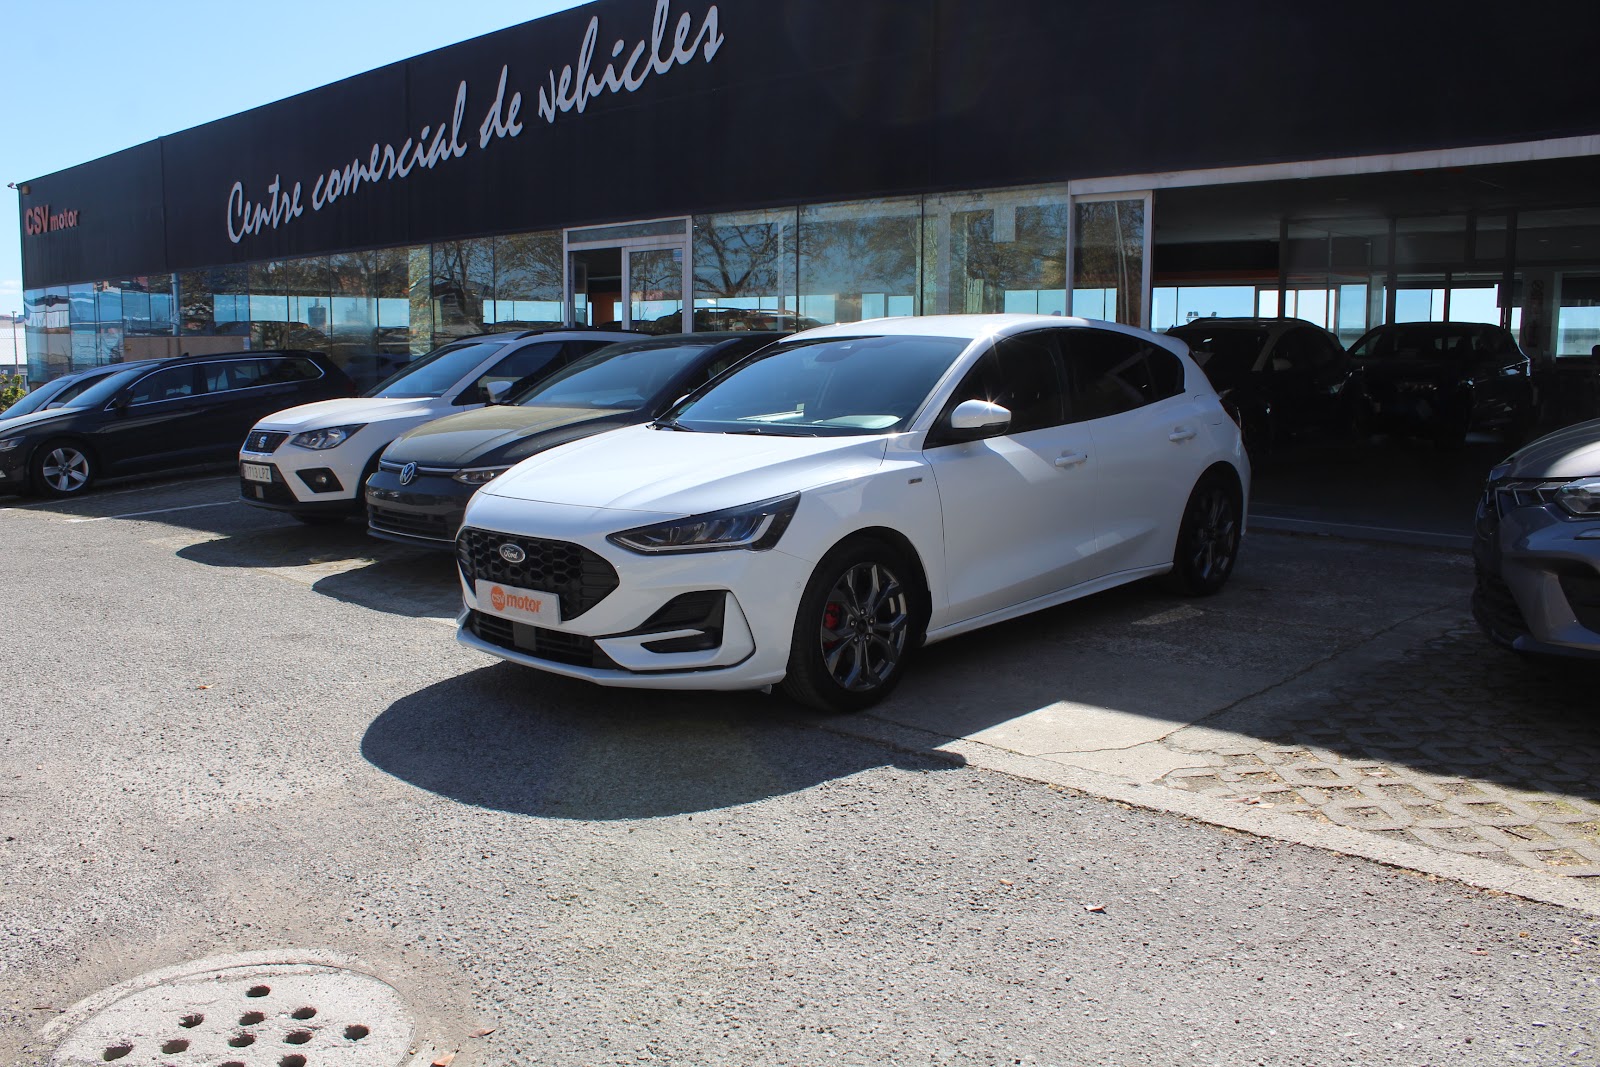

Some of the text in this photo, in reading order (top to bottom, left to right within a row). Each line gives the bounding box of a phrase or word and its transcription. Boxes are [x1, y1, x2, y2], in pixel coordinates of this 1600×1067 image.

[228, 0, 725, 243] Centre comercial de vehicles
[25, 205, 78, 235] CSV motor
[503, 547, 519, 559] Ford
[506, 594, 542, 612] motor
